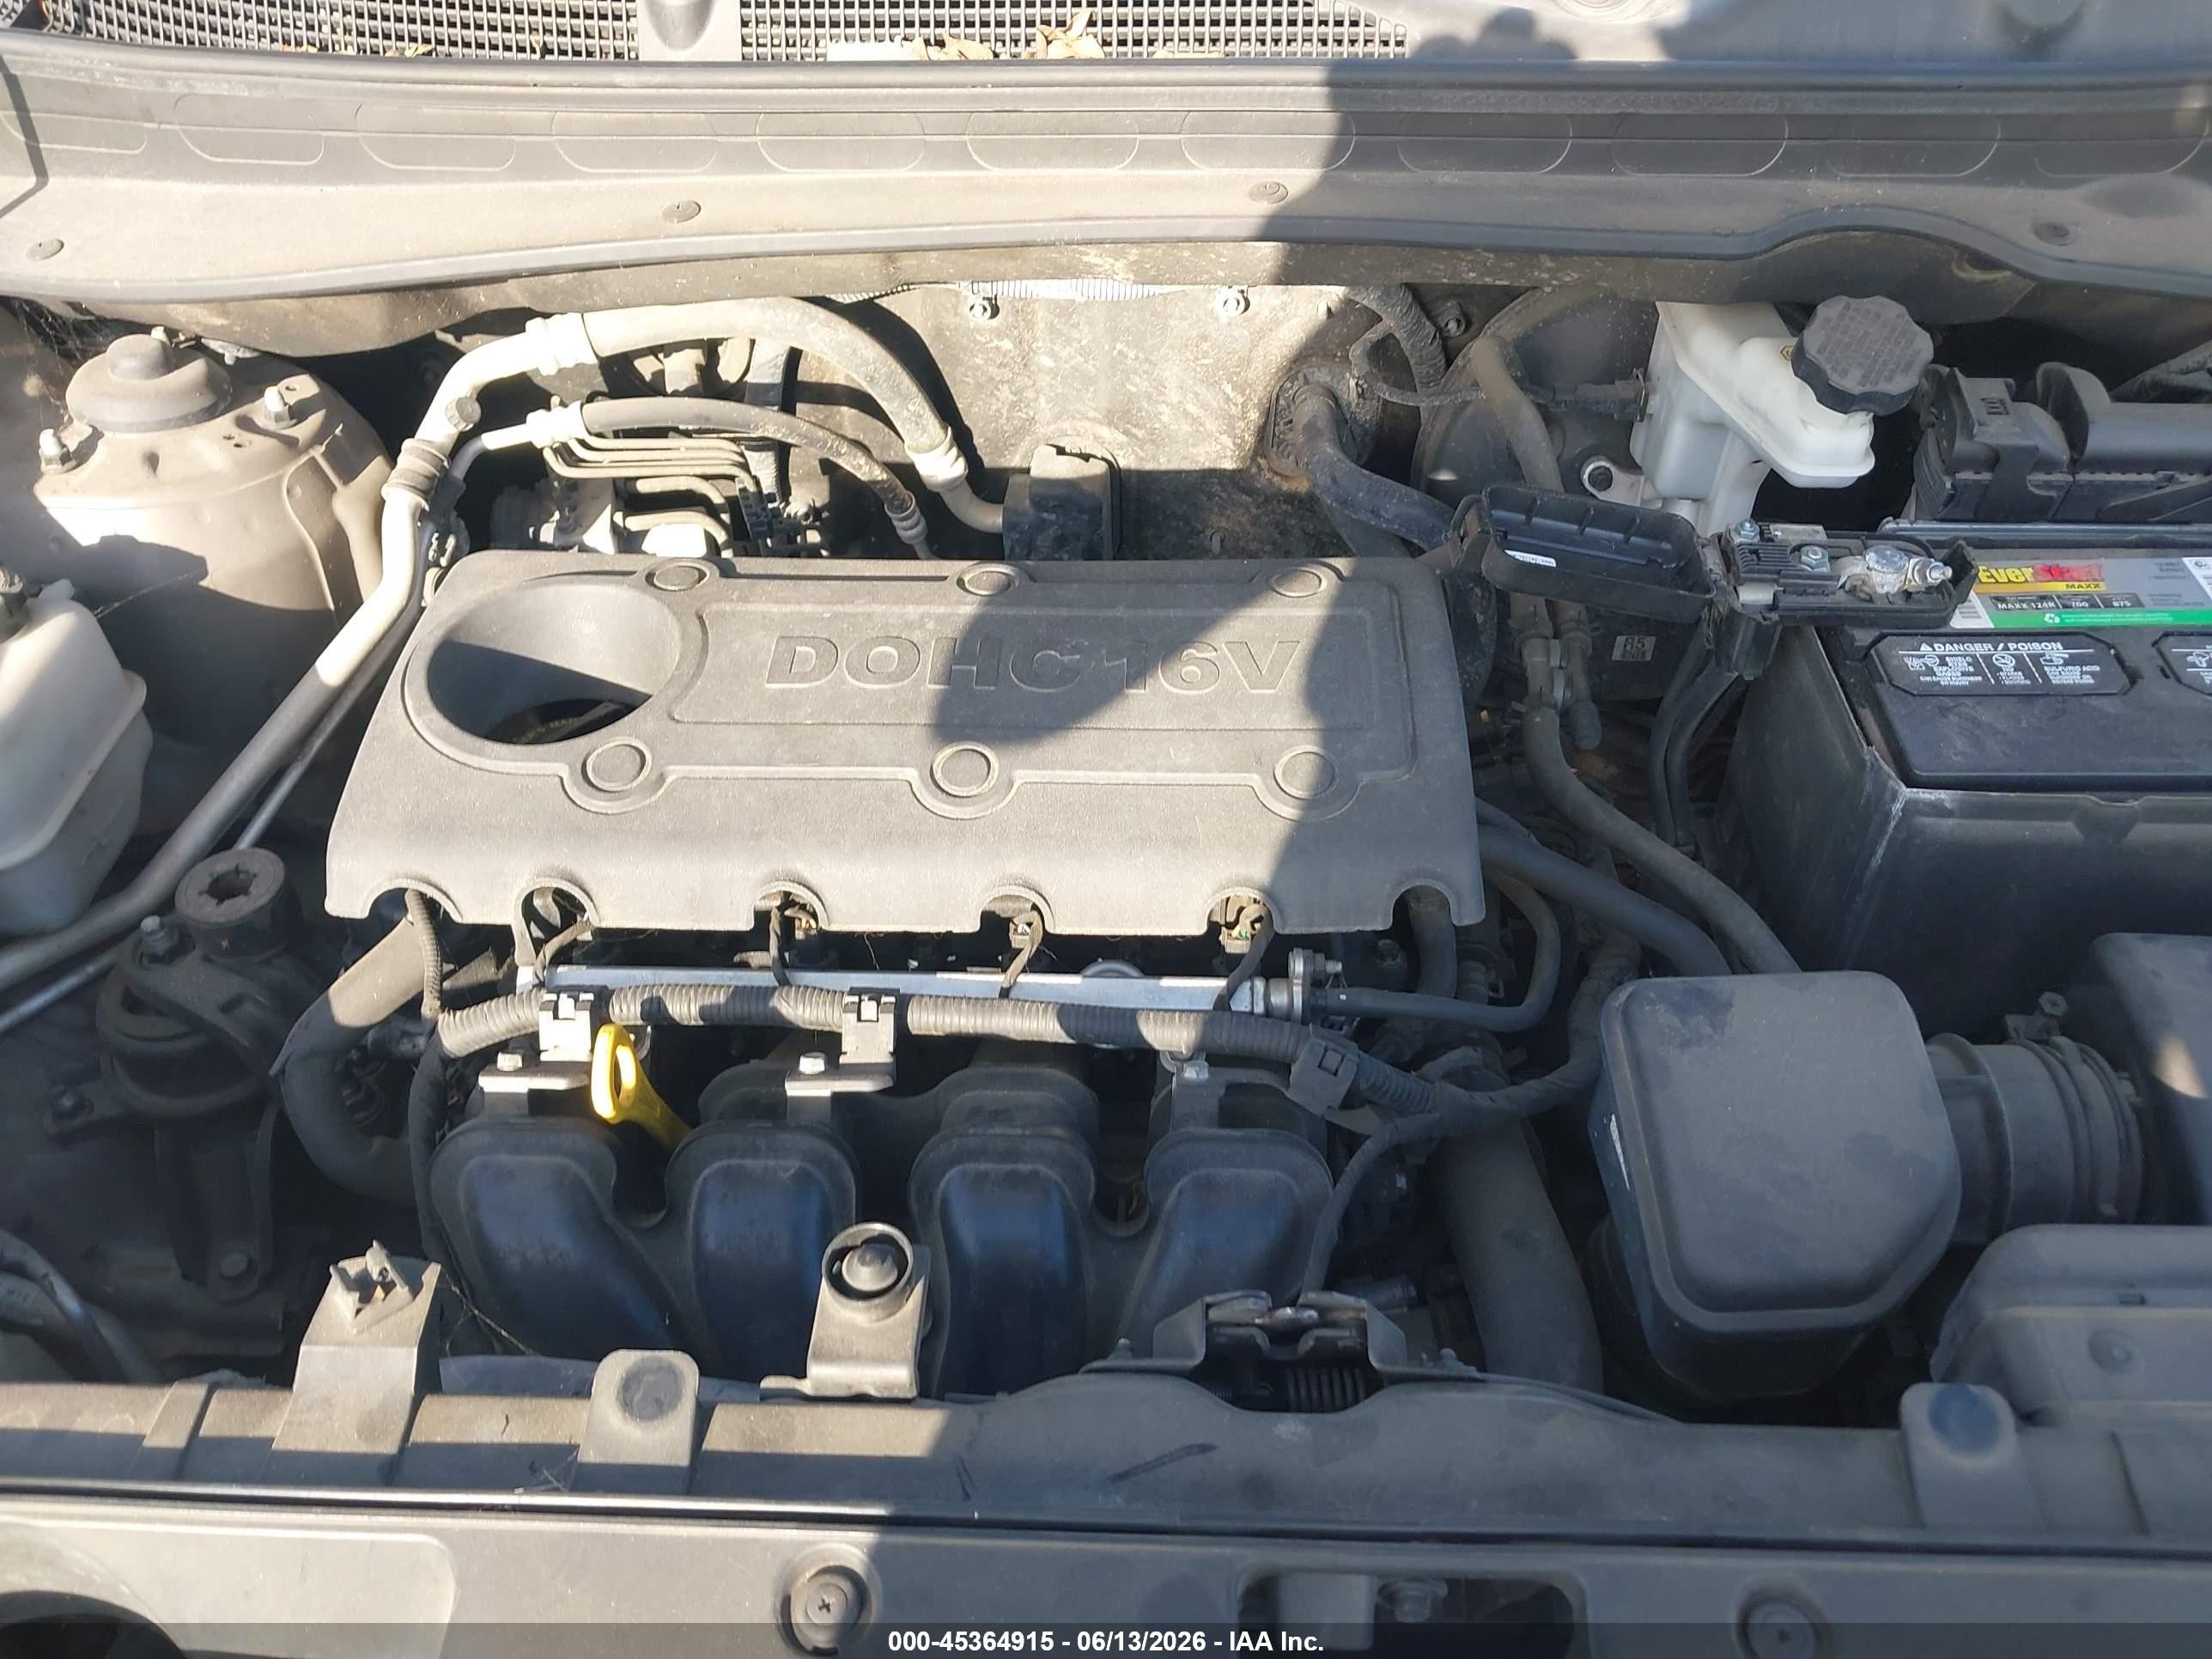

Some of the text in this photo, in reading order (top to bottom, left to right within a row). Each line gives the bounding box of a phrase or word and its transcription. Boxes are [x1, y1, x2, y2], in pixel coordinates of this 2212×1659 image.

[1978, 563, 2102, 584] EverStart
[2008, 642, 2063, 651] POISON
[765, 635, 1300, 694] DOHC 16V
